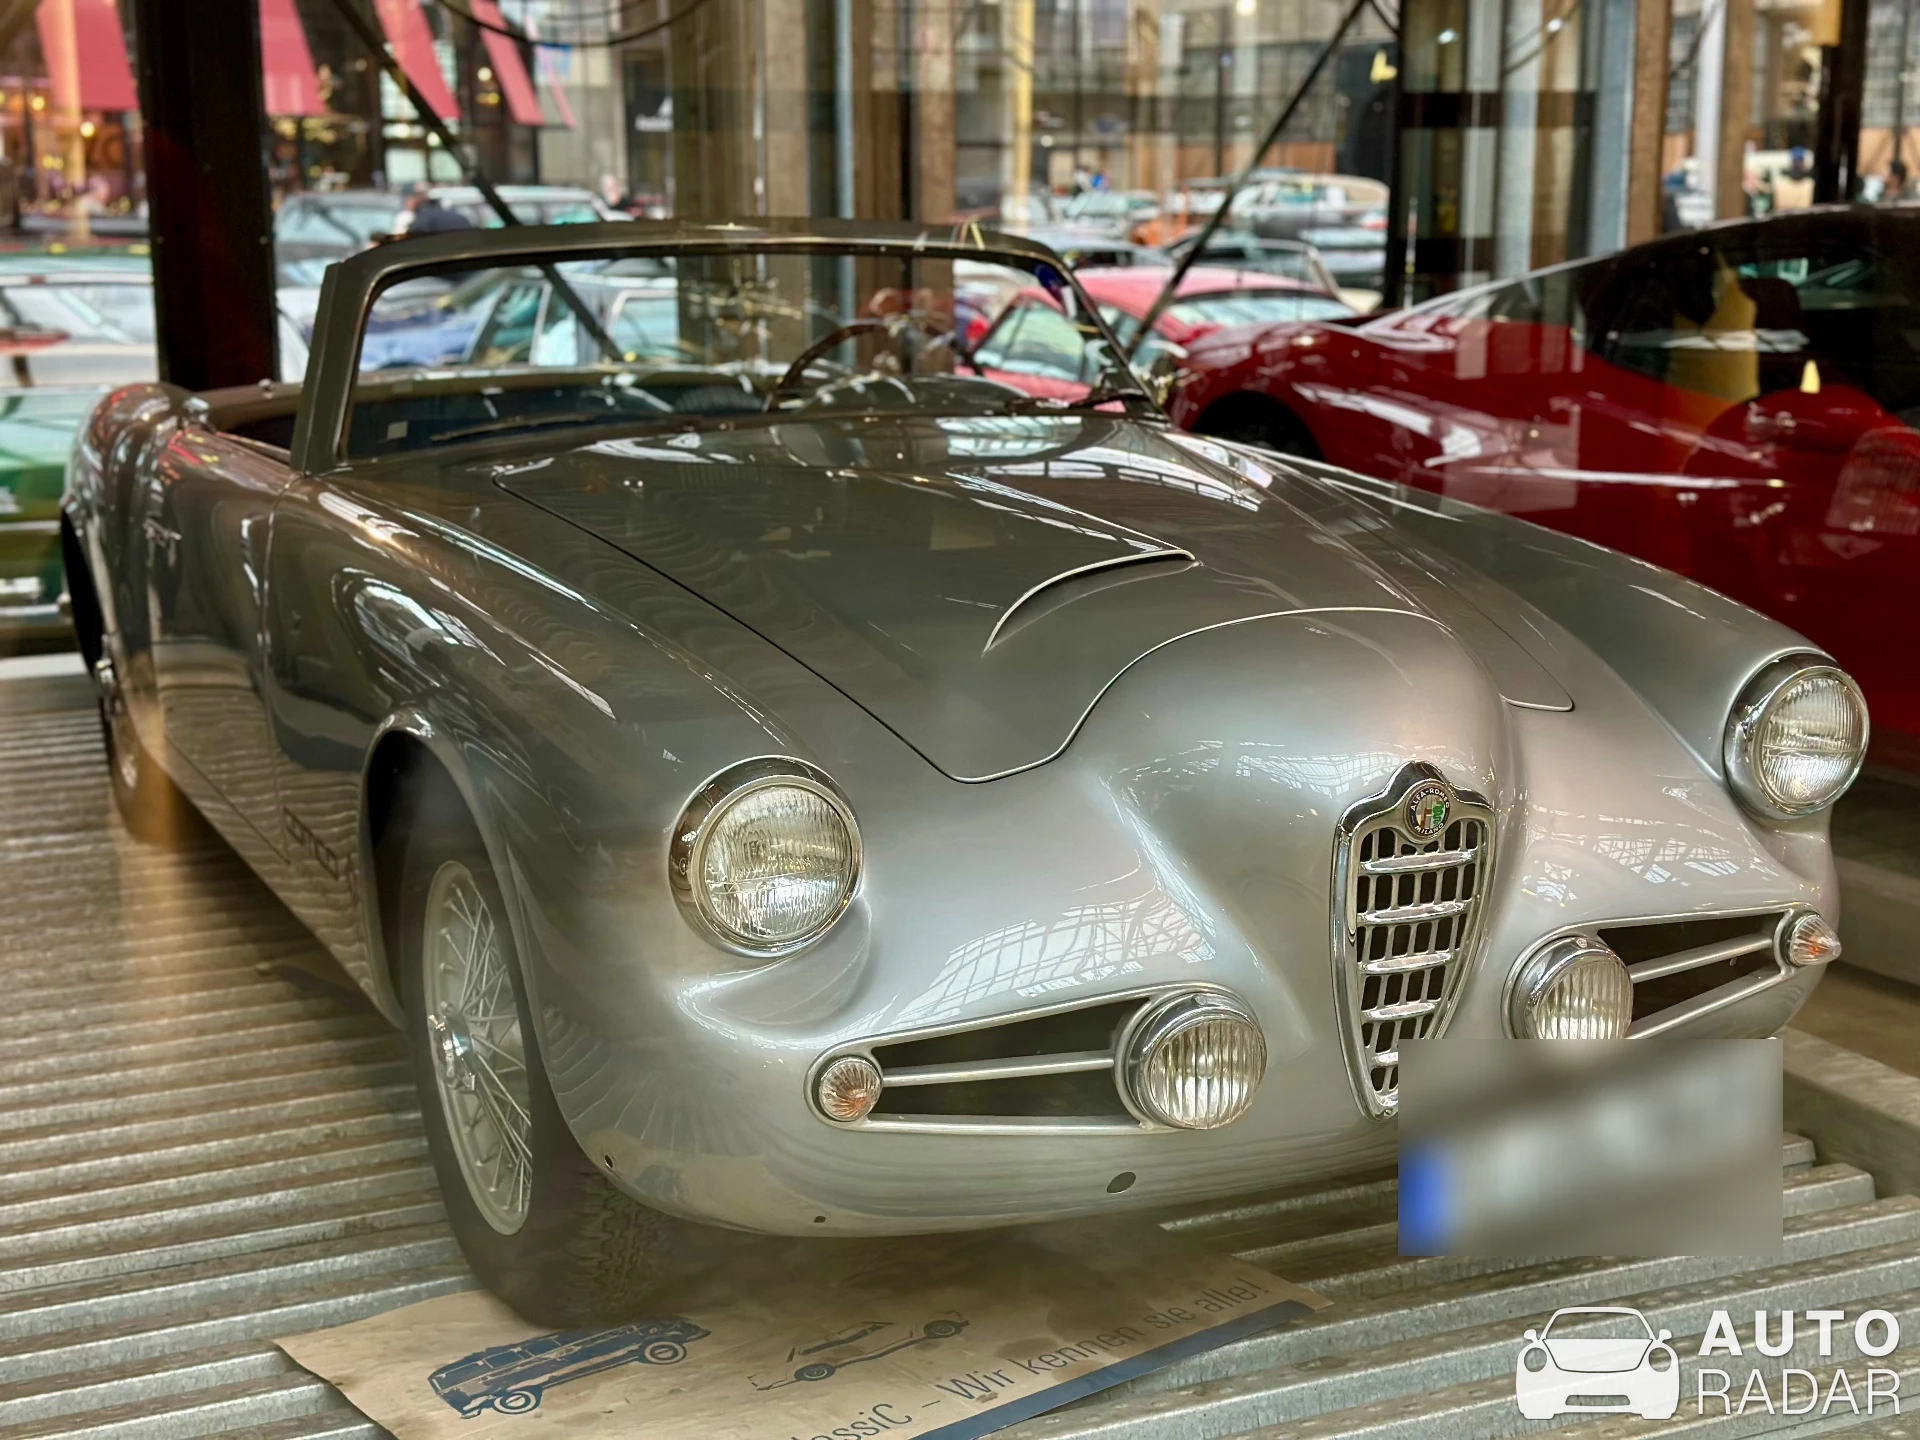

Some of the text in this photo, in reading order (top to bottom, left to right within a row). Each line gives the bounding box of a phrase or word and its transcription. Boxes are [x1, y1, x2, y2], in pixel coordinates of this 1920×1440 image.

[1415, 823, 1444, 834] MILANO
[935, 1369, 1016, 1400] Wir
[1007, 1325, 1146, 1376] kennen
[1195, 1277, 1271, 1312] alle!
